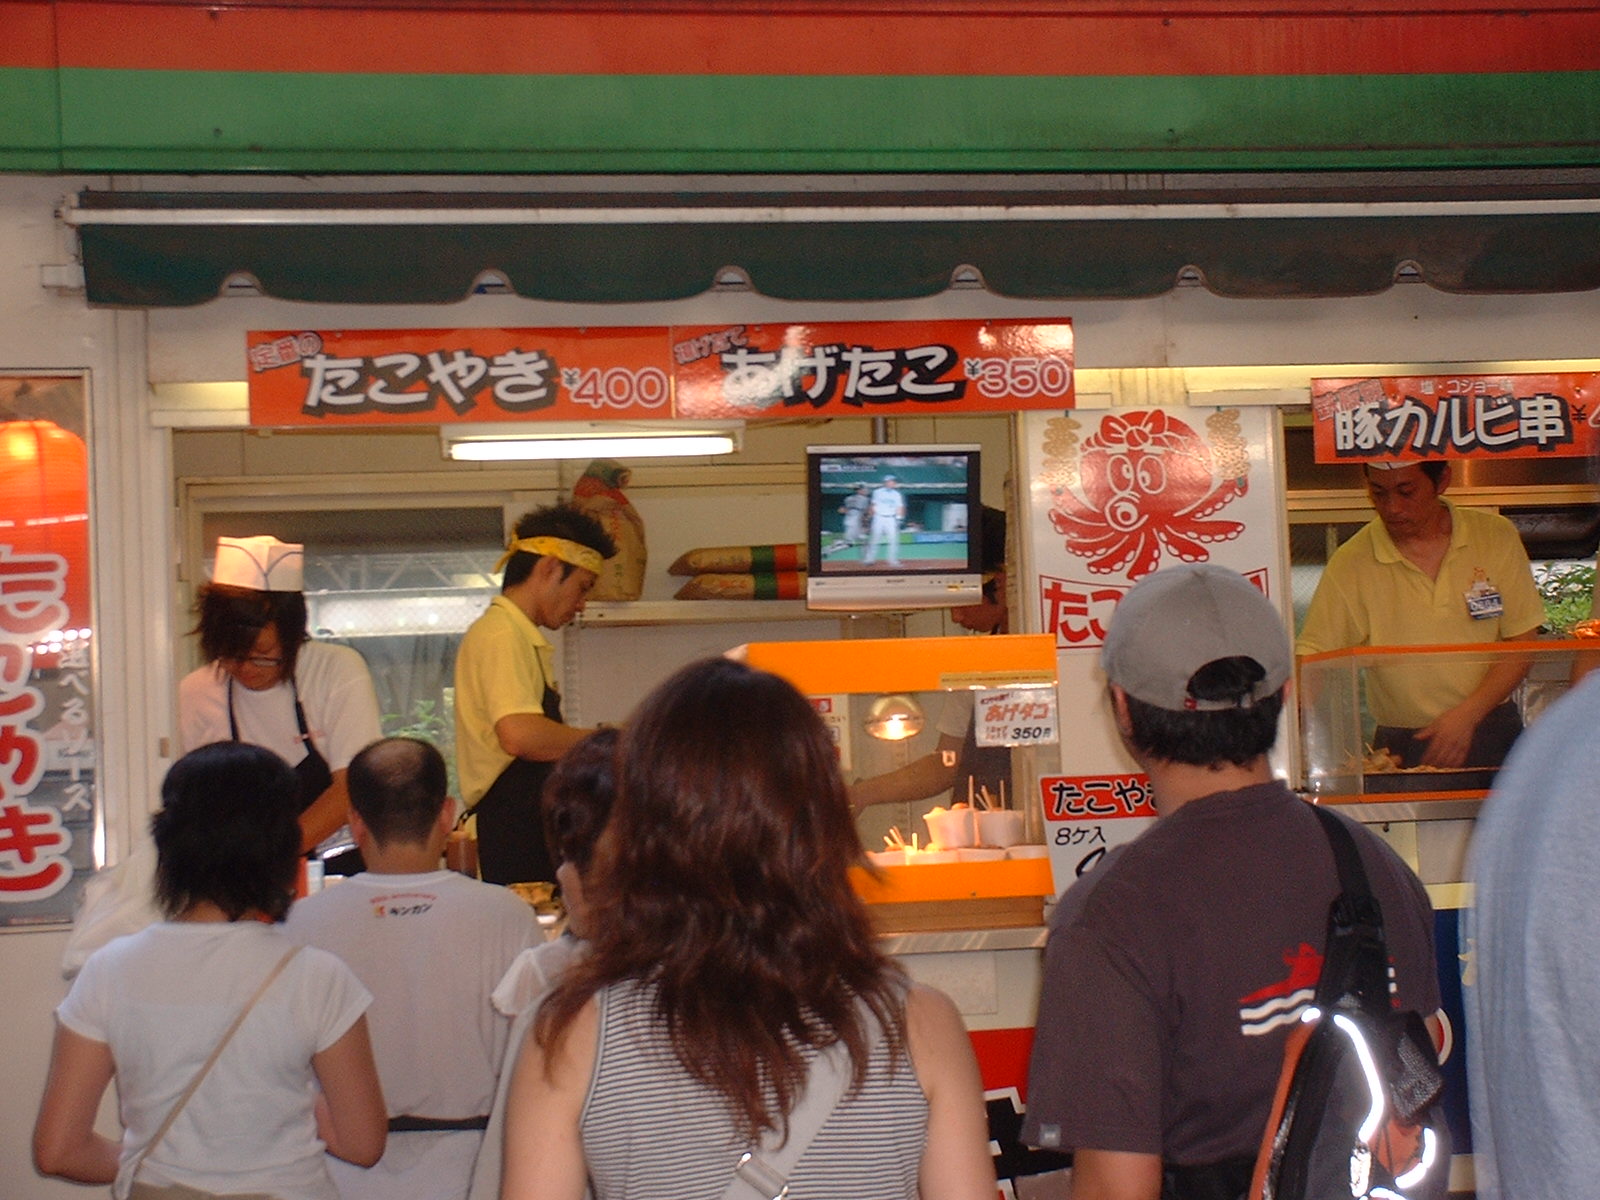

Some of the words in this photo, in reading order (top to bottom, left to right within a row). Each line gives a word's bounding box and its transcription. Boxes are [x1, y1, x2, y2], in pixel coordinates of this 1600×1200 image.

[303, 350, 553, 409] たこやき
[562, 367, 668, 408] ¥400
[722, 346, 958, 402] あげたこ
[964, 357, 1070, 399] ¥350
[1335, 395, 1567, 451] 豚カルビ串
[1051, 779, 1157, 814] たこや
